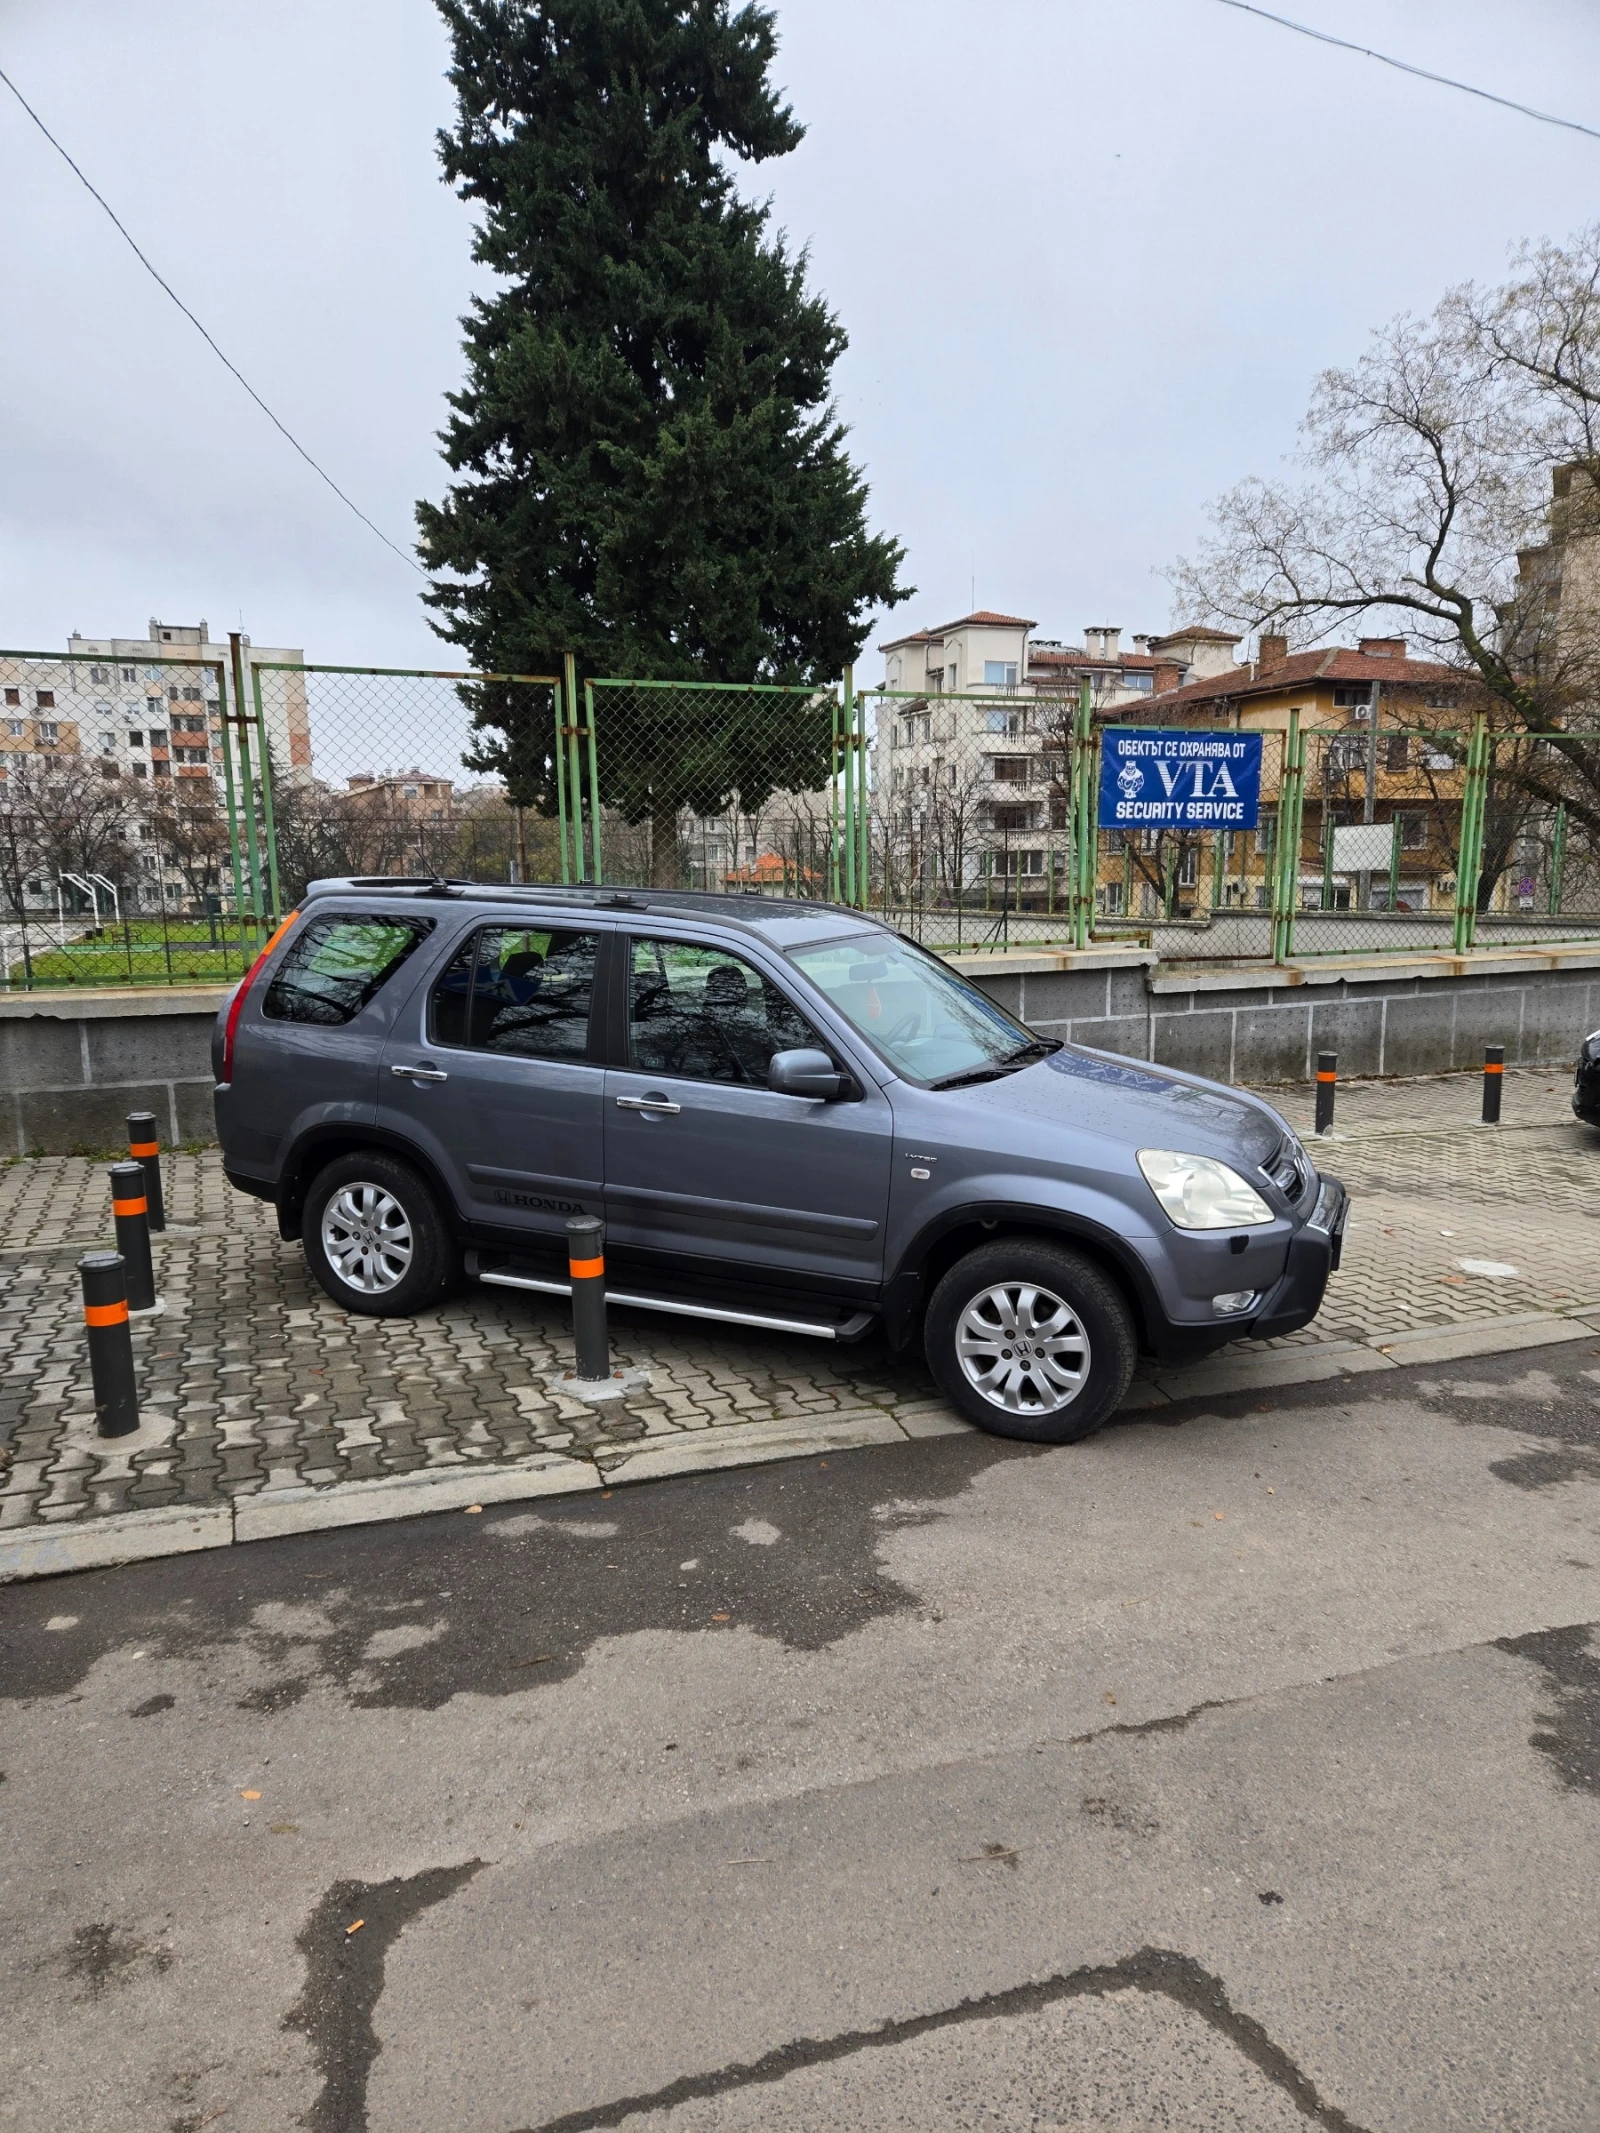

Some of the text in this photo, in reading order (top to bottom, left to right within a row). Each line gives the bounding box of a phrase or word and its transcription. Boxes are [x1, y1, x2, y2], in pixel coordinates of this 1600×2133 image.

[1118, 740, 1246, 758] ОБЕКТЪТ СЕ ОХРАНЯВА ОТ
[1154, 760, 1239, 798] VTA
[1116, 802, 1245, 820] SECURITY SERVICE
[513, 1194, 587, 1215] HONDA
